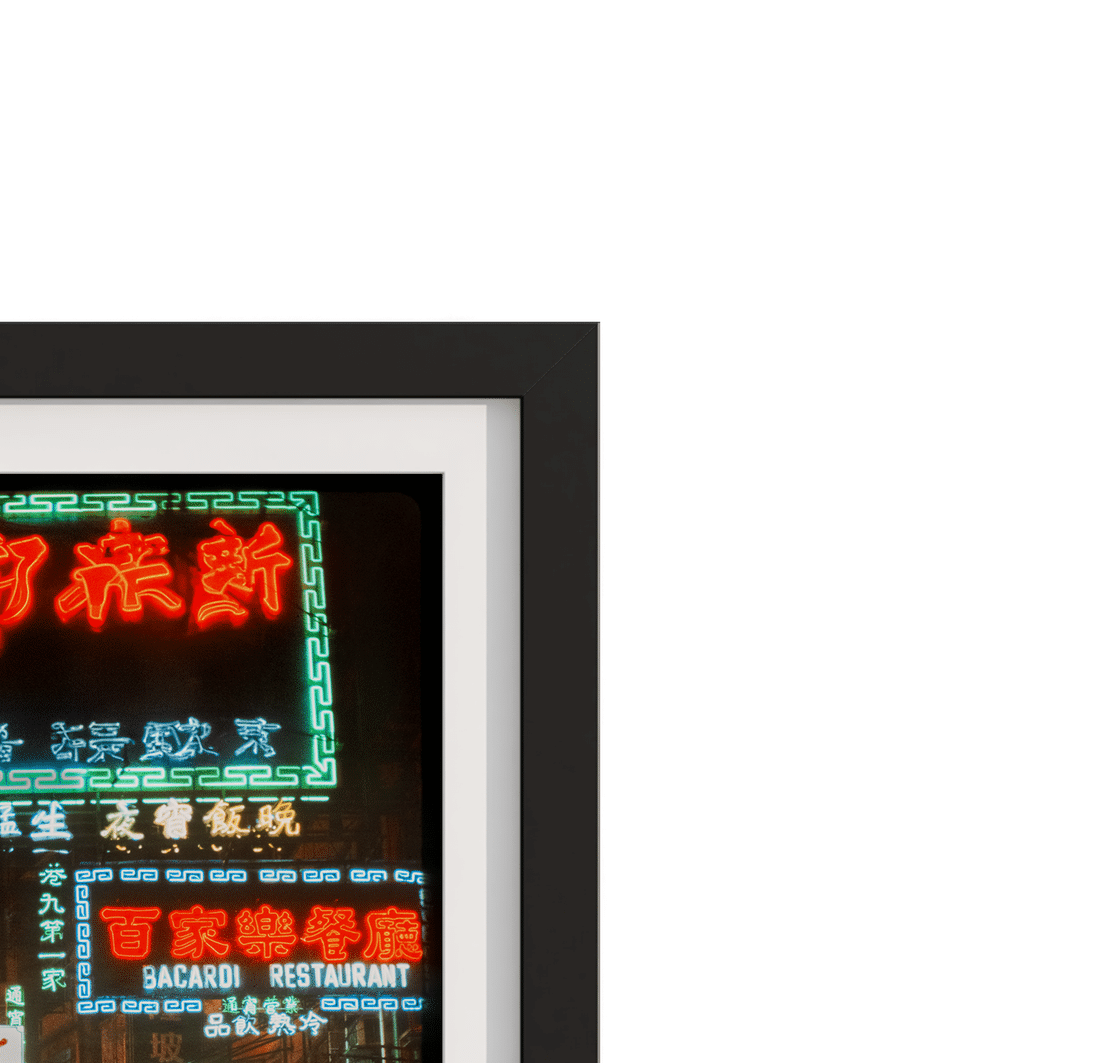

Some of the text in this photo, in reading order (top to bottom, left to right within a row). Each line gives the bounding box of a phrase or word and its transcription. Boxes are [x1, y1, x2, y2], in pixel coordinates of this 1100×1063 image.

[101, 905, 424, 962] 百家樂餐廳
[143, 963, 411, 989] BACARDI RESTAURANT
